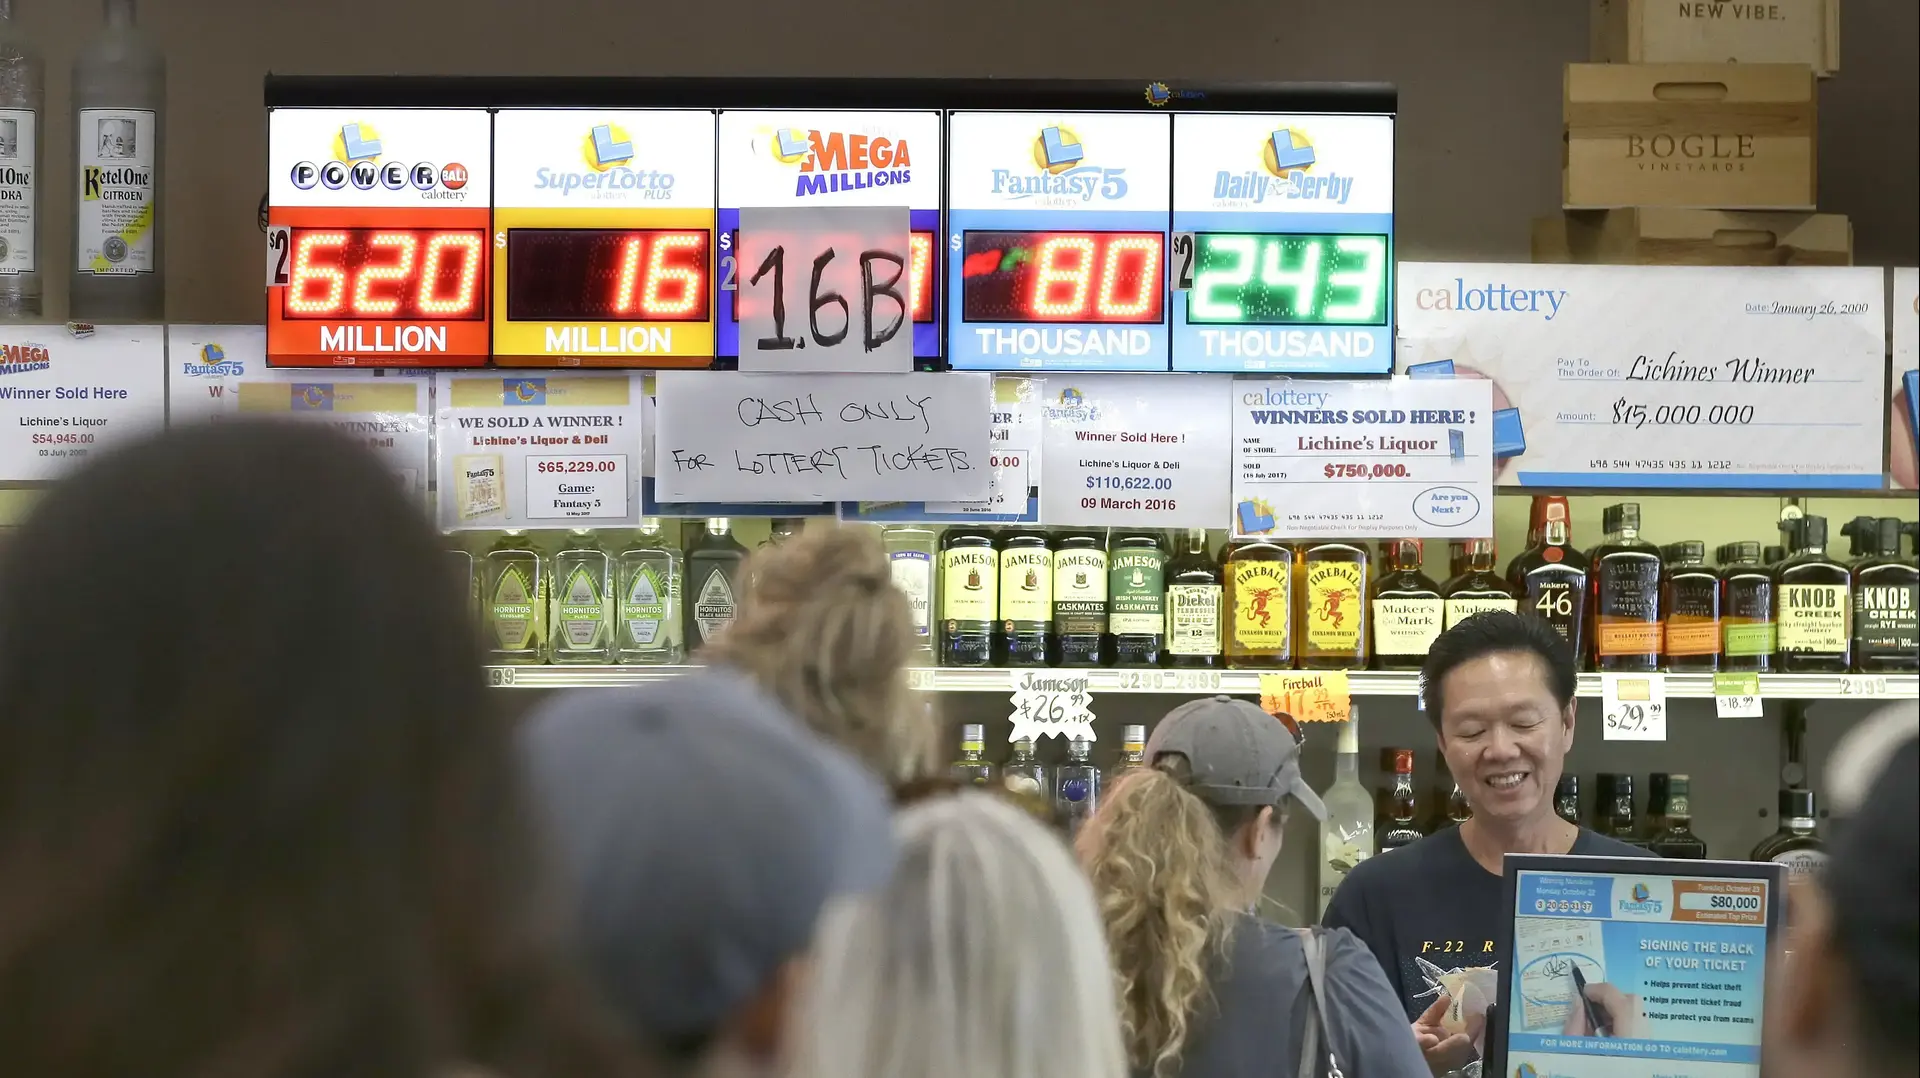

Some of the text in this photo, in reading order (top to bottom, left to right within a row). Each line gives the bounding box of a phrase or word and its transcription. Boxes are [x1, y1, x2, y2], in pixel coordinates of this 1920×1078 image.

[1680, 4, 1786, 21] NEW VIBE.
[800, 130, 911, 172] MEGA
[1625, 133, 1755, 159] BOGLE
[1638, 163, 1745, 172] VINEYARDS
[295, 164, 468, 187] POWER BALL
[534, 167, 675, 196] SuperLotto
[85, 168, 149, 198] Ketel One
[796, 170, 911, 196] MILLIONS
[991, 167, 1128, 201] Fantasy 5
[1214, 171, 1353, 205] Daily Derby
[103, 191, 143, 200] CITROEN
[422, 190, 467, 201] calottery
[644, 190, 672, 199] PLUS
[288, 234, 481, 312] 620
[1034, 237, 1158, 314] 80
[1193, 238, 1385, 320] 243
[750, 246, 905, 353] 1.6B
[1416, 278, 1567, 320] calottery
[1745, 301, 1868, 320] Date: January 26, 2000
[321, 326, 446, 351] MILLION
[545, 327, 672, 353] MILLION
[976, 328, 1151, 355] THOUSAND
[1199, 330, 1374, 358] THOUSAND
[3, 345, 49, 363] MEGA
[0, 362, 49, 375] MILLIONS
[184, 362, 244, 376] Fantasy 5
[1557, 358, 1590, 368] Pay To
[1626, 352, 1815, 383] Lichines Winner
[1557, 369, 1620, 377] The Order Of:
[0, 387, 127, 399] Winner Sold Here
[1243, 388, 1329, 409] calottery
[738, 394, 932, 433] CASH ONLY
[1250, 410, 1466, 424] WINNERS SOLD HERE
[1556, 412, 1596, 421] Amount:
[20, 417, 107, 428] Lichine's Liquor
[458, 416, 614, 429] WE SOLD A WINNER
[32, 434, 94, 445] $54,945.00
[473, 435, 608, 447] Lichine's Liquor & Deli
[1075, 431, 1178, 443] Winner Sold Here
[1298, 436, 1438, 454] Lichine's Liquor
[538, 461, 615, 474] $65,229.00
[672, 446, 848, 479] FOR LOTTERY
[1079, 459, 1180, 470] Lichine's Liquor Deli
[1590, 460, 1608, 468] 698
[1613, 460, 1630, 468] 544
[1635, 460, 1664, 469] 47435
[1669, 461, 1686, 469] 435
[1691, 461, 1702, 469] 11
[1707, 461, 1731, 469] 1212
[1324, 463, 1411, 480] $750,000.
[558, 484, 595, 494] Game:
[1086, 476, 1172, 491] $110,622.00
[1081, 498, 1176, 510] 09 March 2016
[1431, 493, 1448, 501] Are
[553, 500, 592, 509] Fantasy
[1432, 505, 1454, 514] Next
[948, 554, 996, 568] JAMESON
[1005, 554, 1051, 568] JAMESON
[1057, 555, 1105, 570] JAMESON
[1112, 555, 1162, 570] JAMESON
[1236, 567, 1286, 586] FIREBALL
[1309, 567, 1359, 586] FIREBALL
[1177, 594, 1215, 607] Dickel
[1789, 588, 1835, 608] KNOB
[1864, 587, 1910, 609] KNOB
[1058, 603, 1104, 611] CASKMATES
[1382, 605, 1435, 614] Maker's
[1397, 616, 1433, 625] Mark
[1869, 610, 1916, 619] CREEK
[1880, 621, 1896, 629] RYE
[1020, 672, 1089, 692] Jameson
[1120, 673, 1163, 689] 3299
[1176, 673, 1221, 689] 2399
[1283, 676, 1323, 690] Fireball
[1841, 679, 1886, 694] 2999
[1711, 896, 1758, 910] $80,000
[1421, 941, 1464, 953] F-22
[1640, 940, 1754, 954] SIGNING THE BACK
[1646, 956, 1746, 971] OF YOUR TICKET
[1651, 980, 1670, 988] Helps
[1672, 982, 1699, 990] prevent
[1701, 982, 1721, 990] ticket
[1650, 996, 1668, 1004] Helps
[1671, 998, 1697, 1006] prevent
[1701, 998, 1720, 1006] ticket
[1649, 1012, 1668, 1020] Helps
[1670, 1013, 1696, 1021] protect
[1540, 1038, 1727, 1057] FOR MORE INFORMATION GO calottery.com
